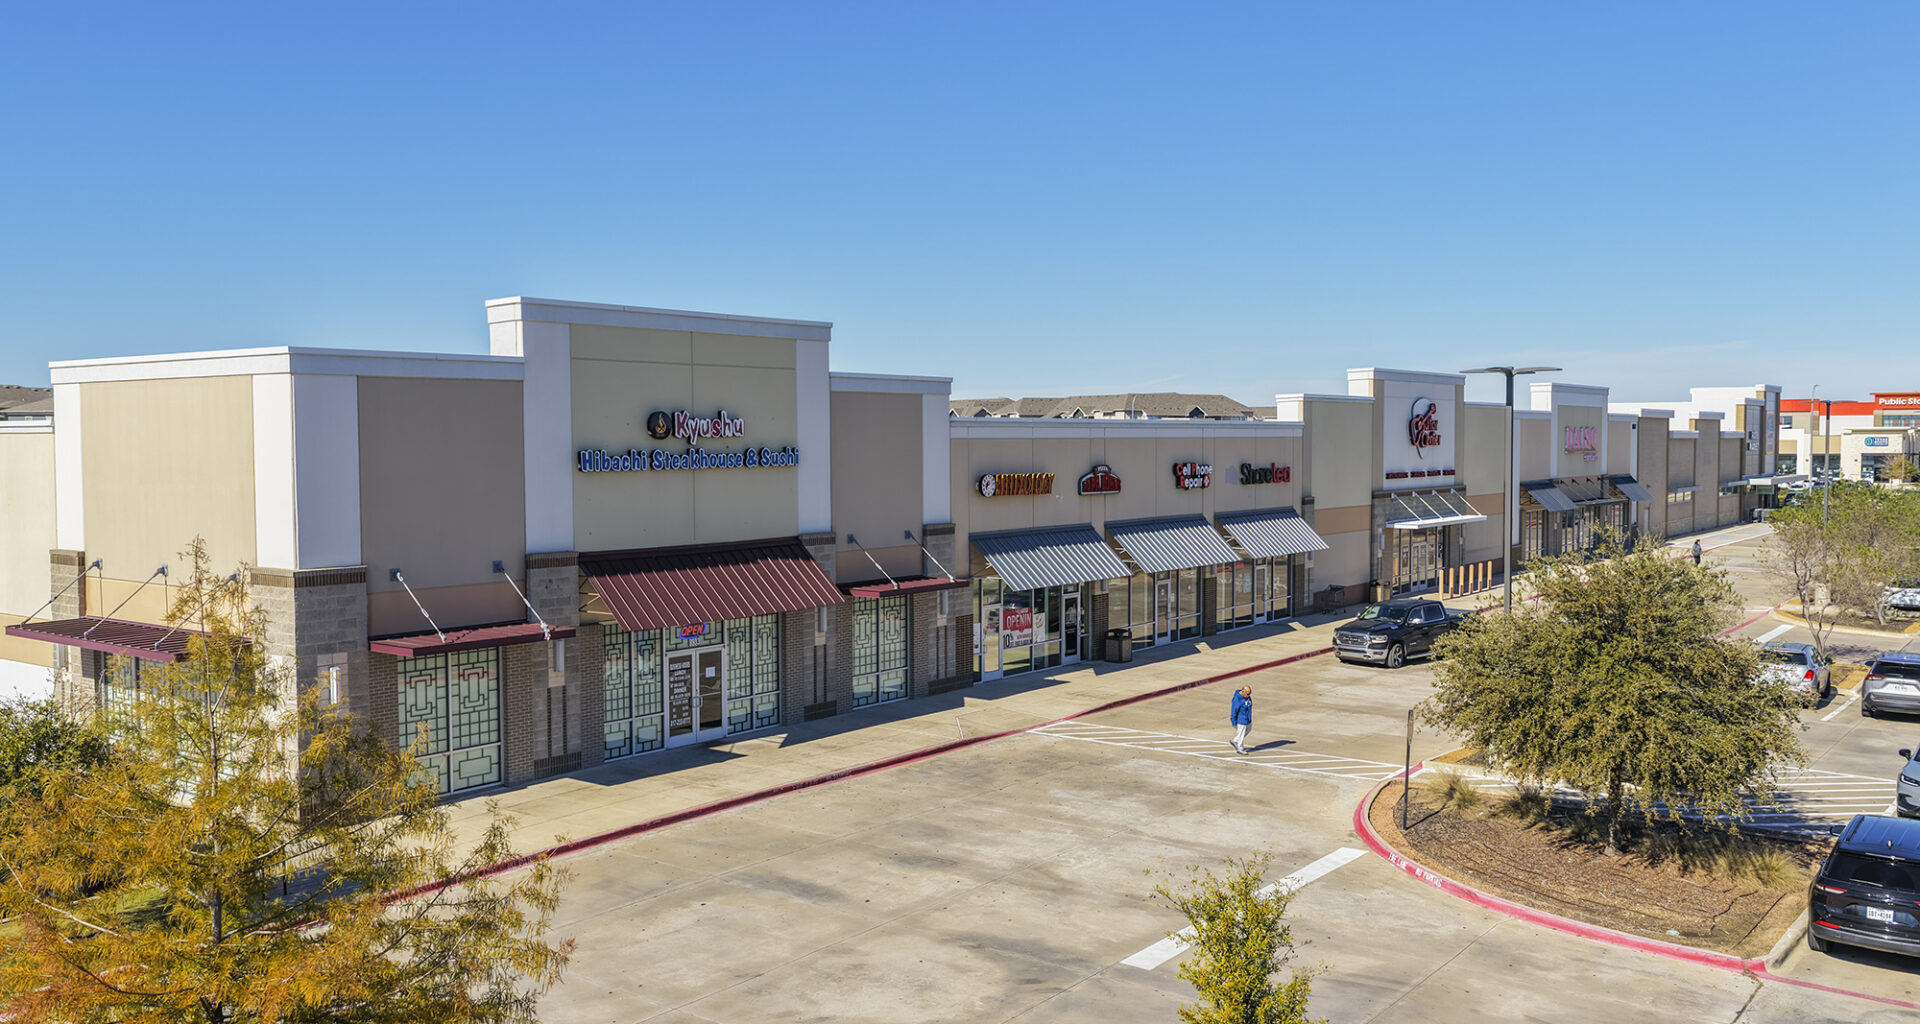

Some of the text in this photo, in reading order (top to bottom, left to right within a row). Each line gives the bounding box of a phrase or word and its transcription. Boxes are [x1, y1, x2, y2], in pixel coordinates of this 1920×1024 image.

[1879, 397, 1907, 406] Public
[673, 409, 744, 445] Kyushu
[1565, 426, 1599, 449] DAISO
[579, 446, 799, 472] Hibachi Steakhouse & Sushi
[1176, 463, 1213, 476] Cell Phone
[1240, 462, 1291, 485] Sharetea
[1180, 475, 1203, 489] Repair
[681, 624, 704, 637] OPEN
